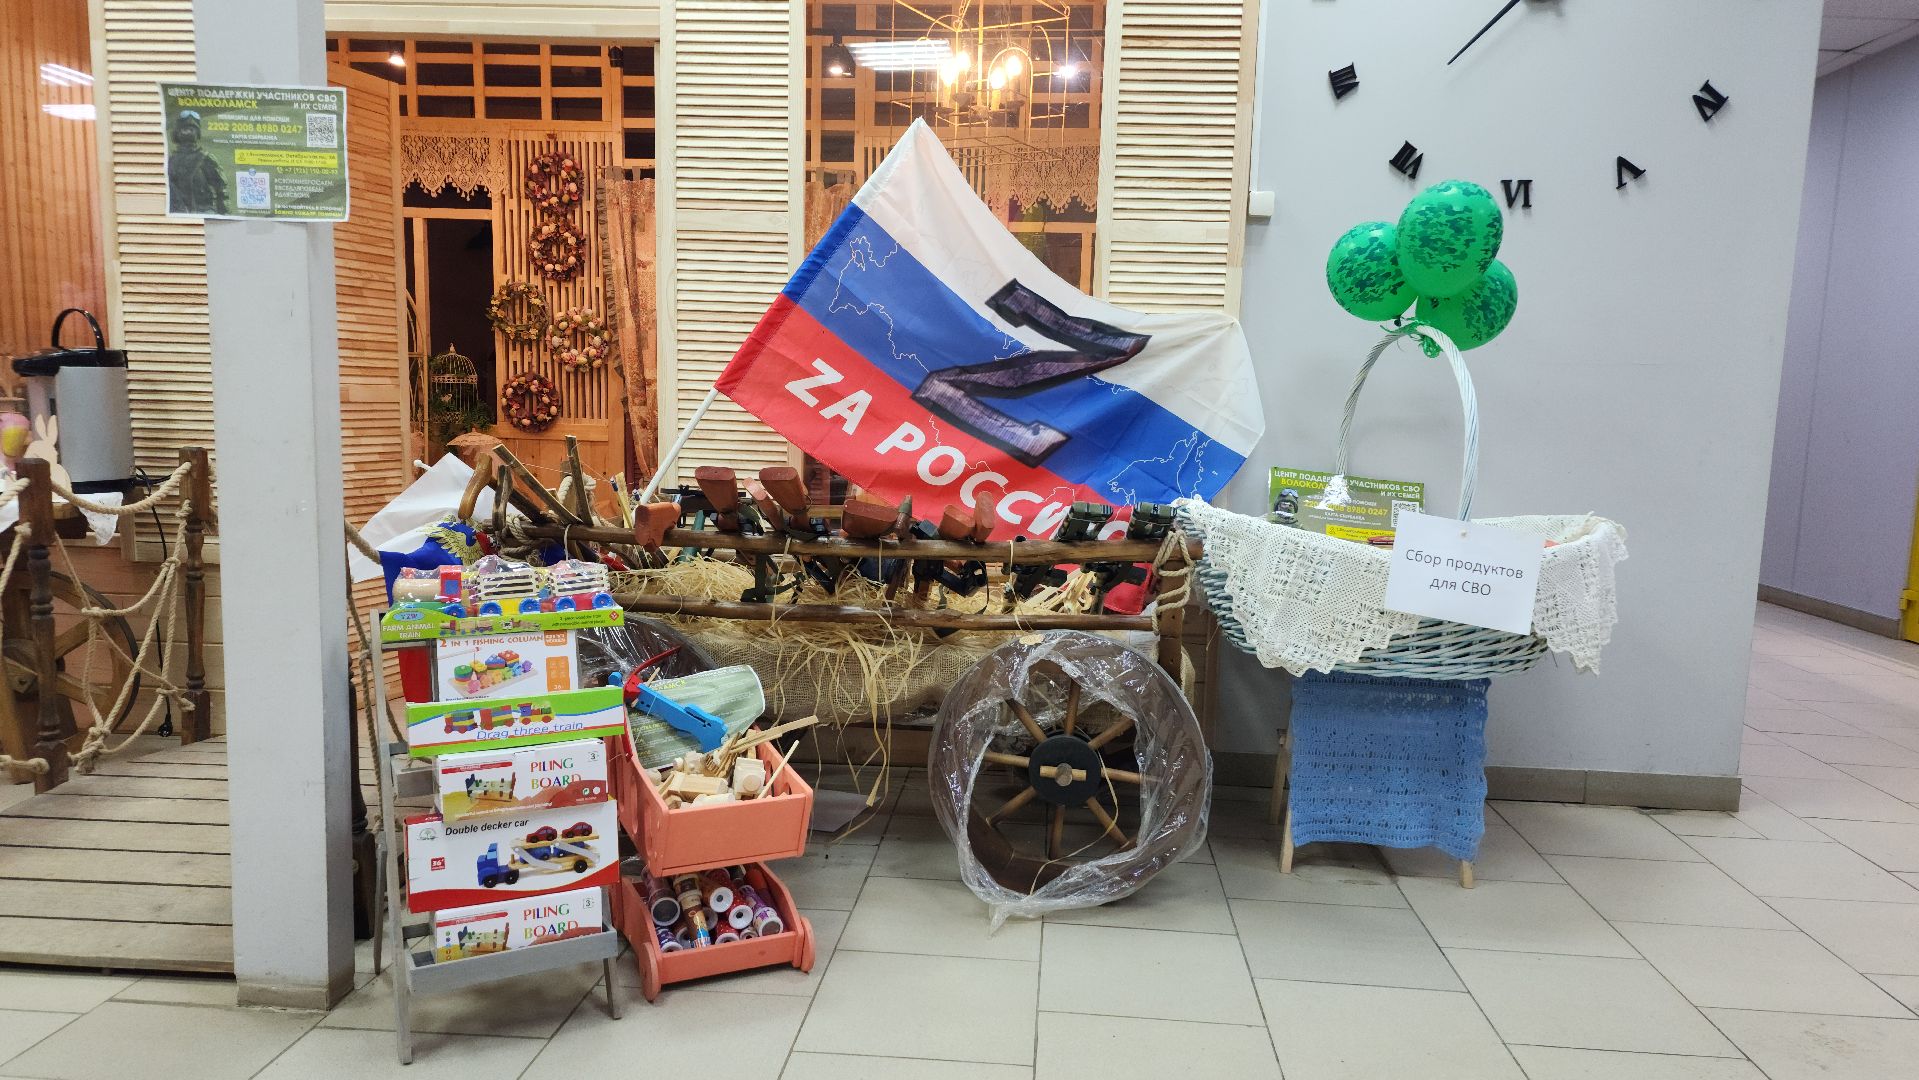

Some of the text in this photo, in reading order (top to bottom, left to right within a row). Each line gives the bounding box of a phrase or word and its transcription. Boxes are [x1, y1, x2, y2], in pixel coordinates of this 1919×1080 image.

[178, 97, 258, 109] ВОЛОКОЛАМСК
[196, 88, 254, 100] ПОДДЕРЖКИ
[256, 91, 315, 102] УЧАСТНИКОВ
[317, 94, 337, 103] СВО
[300, 102, 311, 110] ИХ
[312, 102, 337, 111] СЕМЕЙ
[785, 357, 872, 435] ZA
[1274, 470, 1298, 479] ЦЕНТР
[1349, 479, 1400, 490] УЧАСТНИКОВ
[1402, 485, 1420, 493] СВО
[1367, 507, 1388, 516] 0247
[1405, 549, 1524, 579] Сбор продуктов
[1429, 578, 1492, 596] для СВО
[440, 638, 448, 648] 2
[472, 636, 505, 646] FISHING
[507, 635, 544, 644] COLUMN
[477, 722, 583, 740] Drag three train
[530, 757, 574, 773] PILING
[531, 773, 582, 790] BOARD
[445, 826, 479, 836] Double
[480, 820, 512, 832] decker
[523, 903, 570, 921] PILING
[524, 920, 579, 940] BOARD
